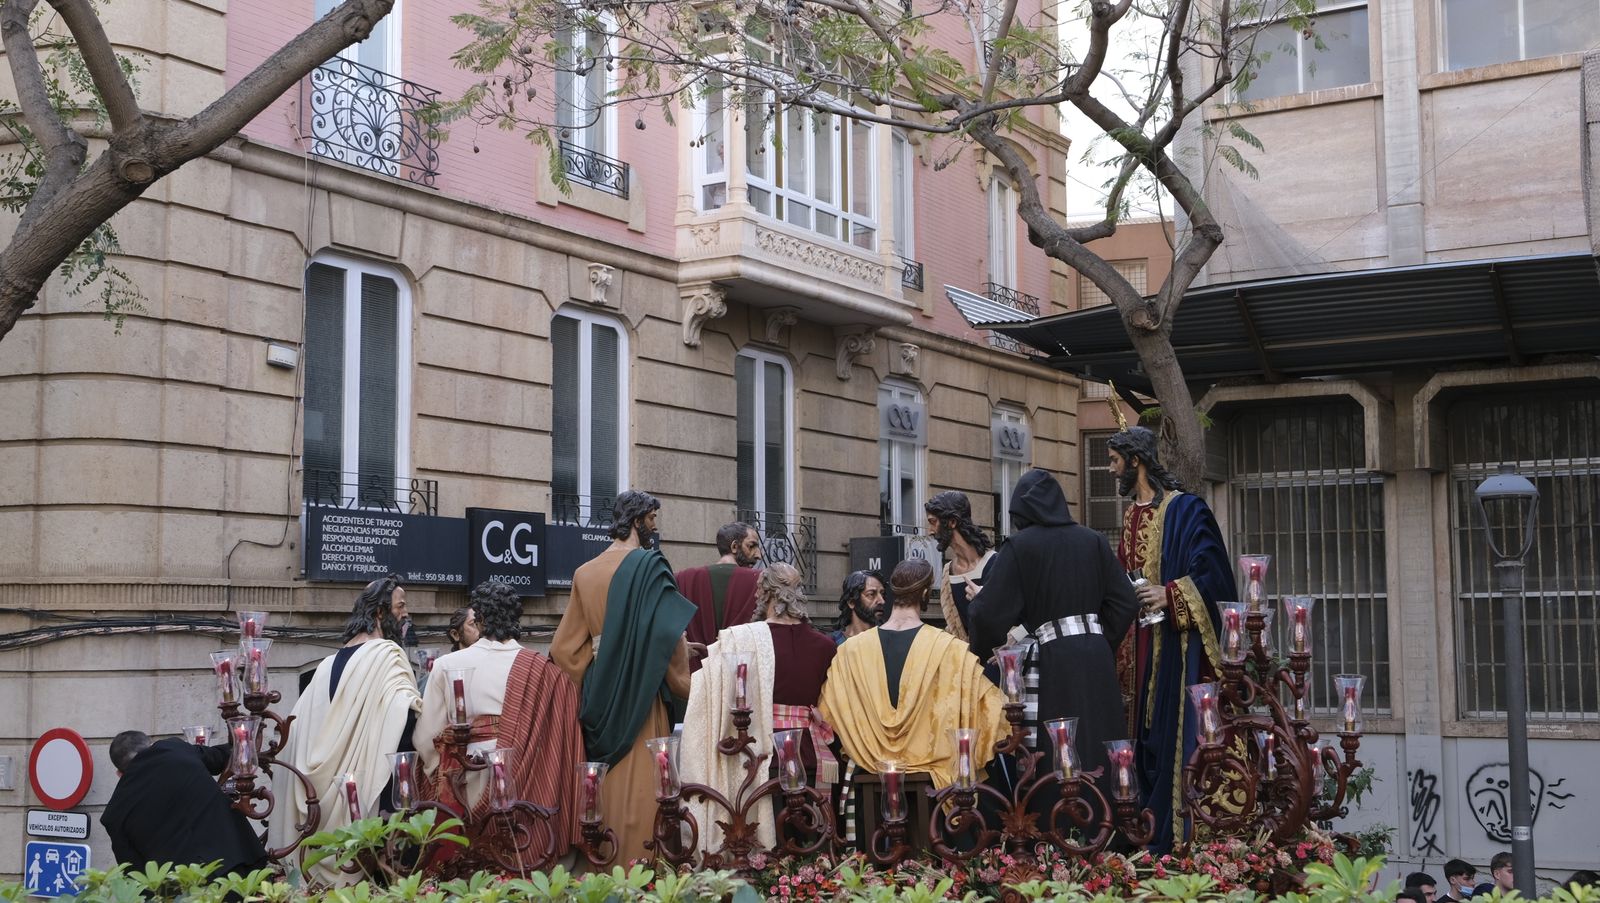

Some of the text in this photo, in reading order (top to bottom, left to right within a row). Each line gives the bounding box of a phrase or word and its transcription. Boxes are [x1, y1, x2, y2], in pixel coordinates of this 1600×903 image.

[322, 515, 404, 528] ACCIDENTES DE TRAFICO
[322, 525, 400, 537] NEGLIGENCIAS MEDICAS
[322, 534, 398, 546] RESPONSABILIDAD CIVIL
[481, 520, 538, 567] C&G
[321, 544, 374, 553] ALCOHOLEMIAS
[321, 553, 377, 563] DERECHO PENAL
[321, 561, 346, 571] DAÑOS
[353, 564, 388, 574] PERJUICIOS
[425, 573, 437, 581] 950
[437, 573, 446, 581] 58
[446, 574, 454, 582] 49
[455, 574, 463, 582] 18
[488, 574, 531, 586] ABOGADOS
[54, 826, 85, 834] AUTORIZADOS
